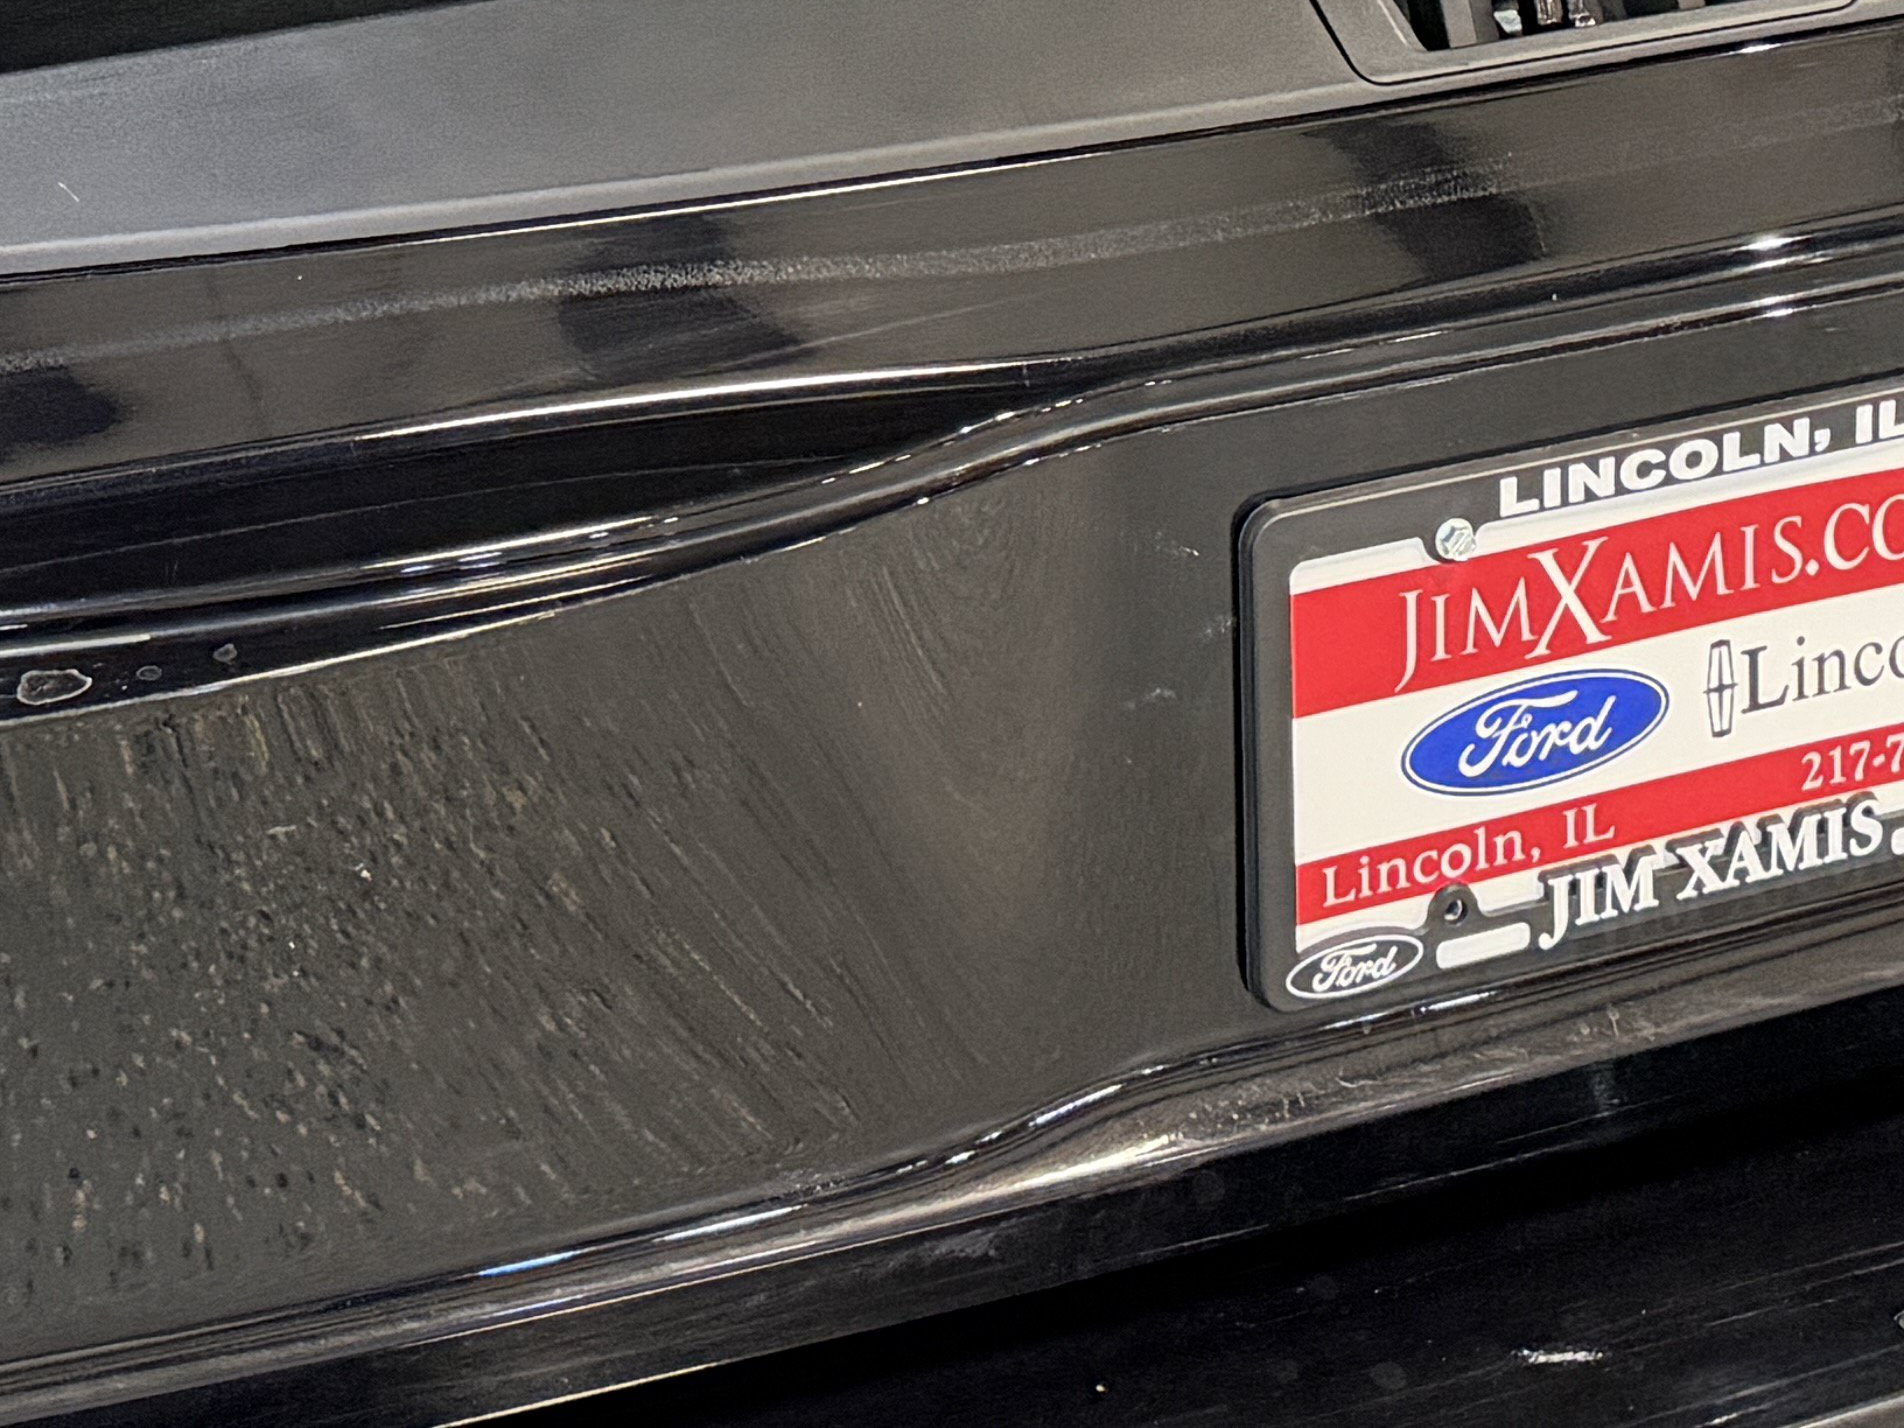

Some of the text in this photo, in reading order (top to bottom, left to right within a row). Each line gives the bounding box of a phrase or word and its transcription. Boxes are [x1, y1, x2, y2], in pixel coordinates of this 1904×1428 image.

[1499, 417, 1831, 518] LINCOLN,
[1458, 689, 1617, 778] Ford
[1321, 802, 1616, 908] Lincoln, IL
[1538, 798, 1884, 950] JIM XAMIS
[1311, 943, 1399, 993] Ford
